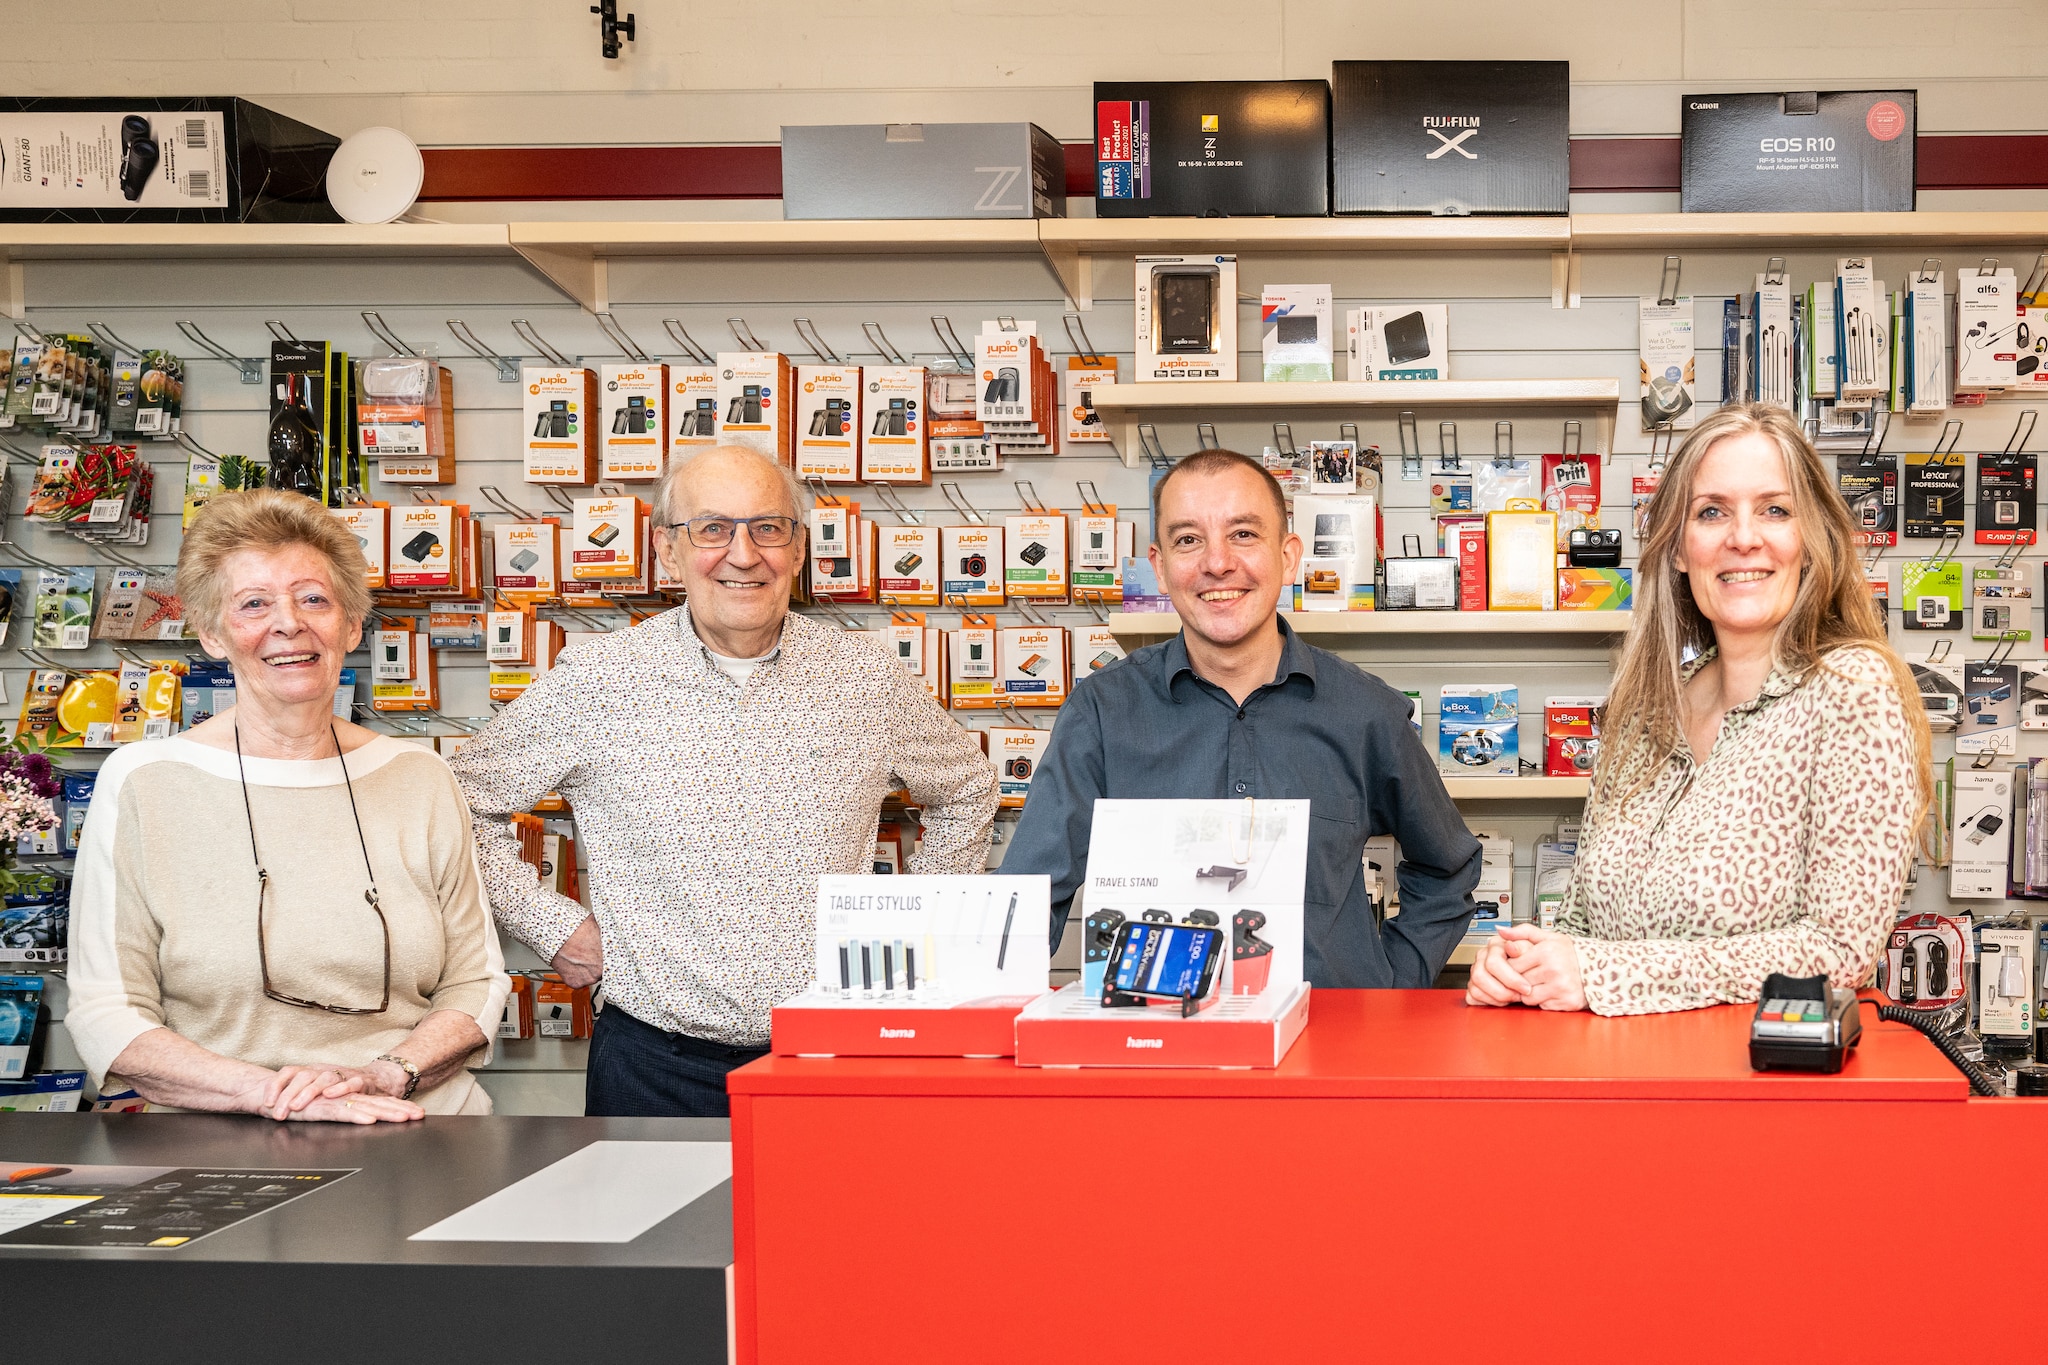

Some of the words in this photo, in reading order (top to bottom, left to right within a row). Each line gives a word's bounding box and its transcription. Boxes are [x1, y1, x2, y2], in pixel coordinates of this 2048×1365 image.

[1690, 102, 1719, 110] Canon
[1423, 116, 1480, 128] FUJIFILM
[1112, 120, 1121, 159] Product
[1142, 132, 1148, 141] 50
[1102, 136, 1111, 159] Best
[1204, 138, 1216, 149] Z
[1426, 129, 1478, 160] X
[1760, 138, 1802, 152] EOS
[1806, 137, 1836, 152] R10
[21, 138, 32, 182] GIANT-80
[1205, 150, 1216, 158] 50
[1776, 164, 1798, 172] Adapter
[1102, 167, 1113, 197] EISA
[973, 166, 1024, 211] Z
[986, 340, 1018, 354] jupio
[1160, 356, 1189, 369] jupio
[540, 374, 568, 385] jupio
[617, 370, 645, 382] jupio
[686, 372, 714, 384] jupio
[814, 372, 842, 384] jupio
[1080, 374, 1100, 383] jupio
[363, 409, 387, 420] jupio
[934, 422, 958, 434] jupio
[1556, 466, 1587, 482] Pritt
[1921, 470, 1950, 480] Lexar
[406, 508, 436, 522] jupio
[818, 510, 838, 518] jupio
[1088, 519, 1106, 528] jupio
[894, 530, 924, 542] jupio
[958, 531, 988, 544] jupio
[432, 614, 450, 624] jupio
[496, 613, 515, 621] jupio
[382, 632, 400, 640] jupio
[895, 628, 914, 636] jupio
[966, 630, 985, 638] jupio
[1018, 631, 1048, 644] jupio
[211, 678, 234, 686] brother
[1442, 703, 1470, 712] LeBox
[1552, 714, 1580, 722] LeBox
[1005, 734, 1035, 746] jupio
[1989, 734, 2010, 750] 64
[1095, 877, 1128, 888] TRAVEL
[1130, 878, 1158, 888] STAND
[830, 896, 872, 910] TABLET
[876, 896, 922, 911] STYLUS
[1190, 932, 1206, 960] 11:00
[880, 1026, 916, 1038] hama
[1126, 1036, 1163, 1048] hama
[56, 1078, 80, 1086] brother
